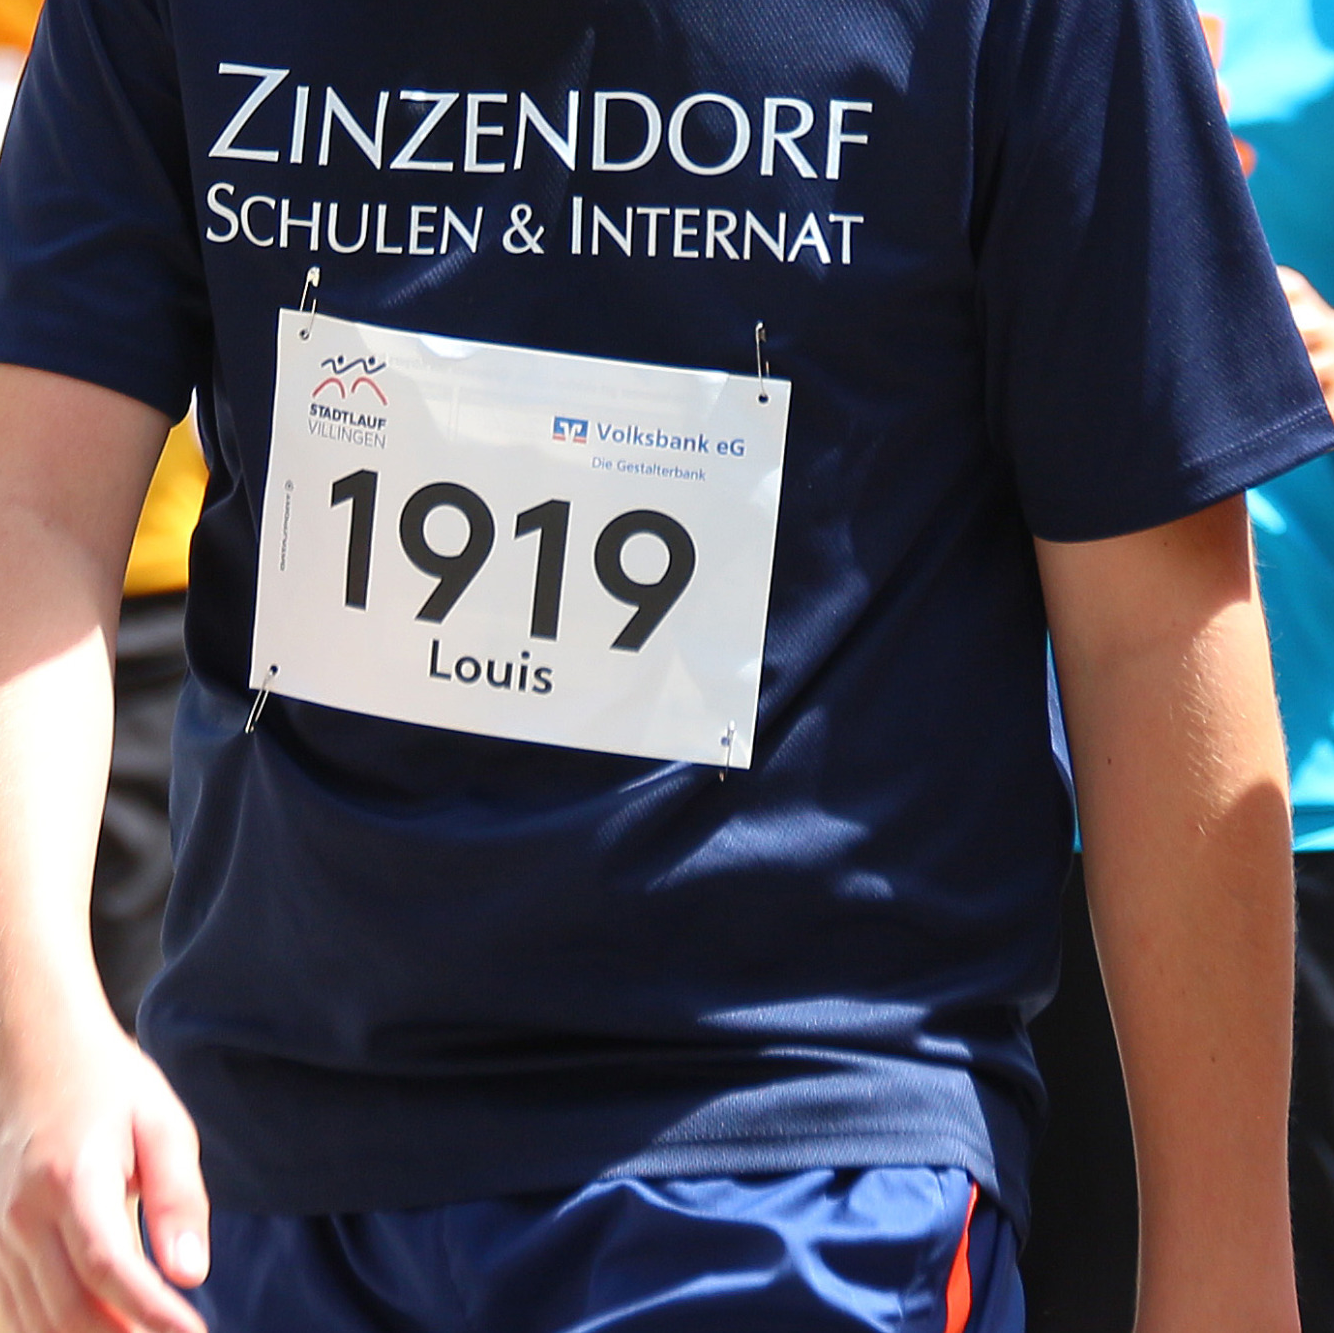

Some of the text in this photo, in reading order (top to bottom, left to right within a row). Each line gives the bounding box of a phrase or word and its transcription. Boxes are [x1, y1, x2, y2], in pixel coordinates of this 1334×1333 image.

[208, 62, 873, 180] ZINZENDORF
[205, 182, 865, 265] SCHULEN & INTERNAT
[308, 420, 387, 450] VILLINGEN
[309, 403, 387, 431] STADTLAUF
[596, 422, 746, 457] Volksbank eG
[591, 456, 707, 482] Die Gestalterbank
[329, 467, 698, 653] 1919
[428, 639, 554, 695] Louis
